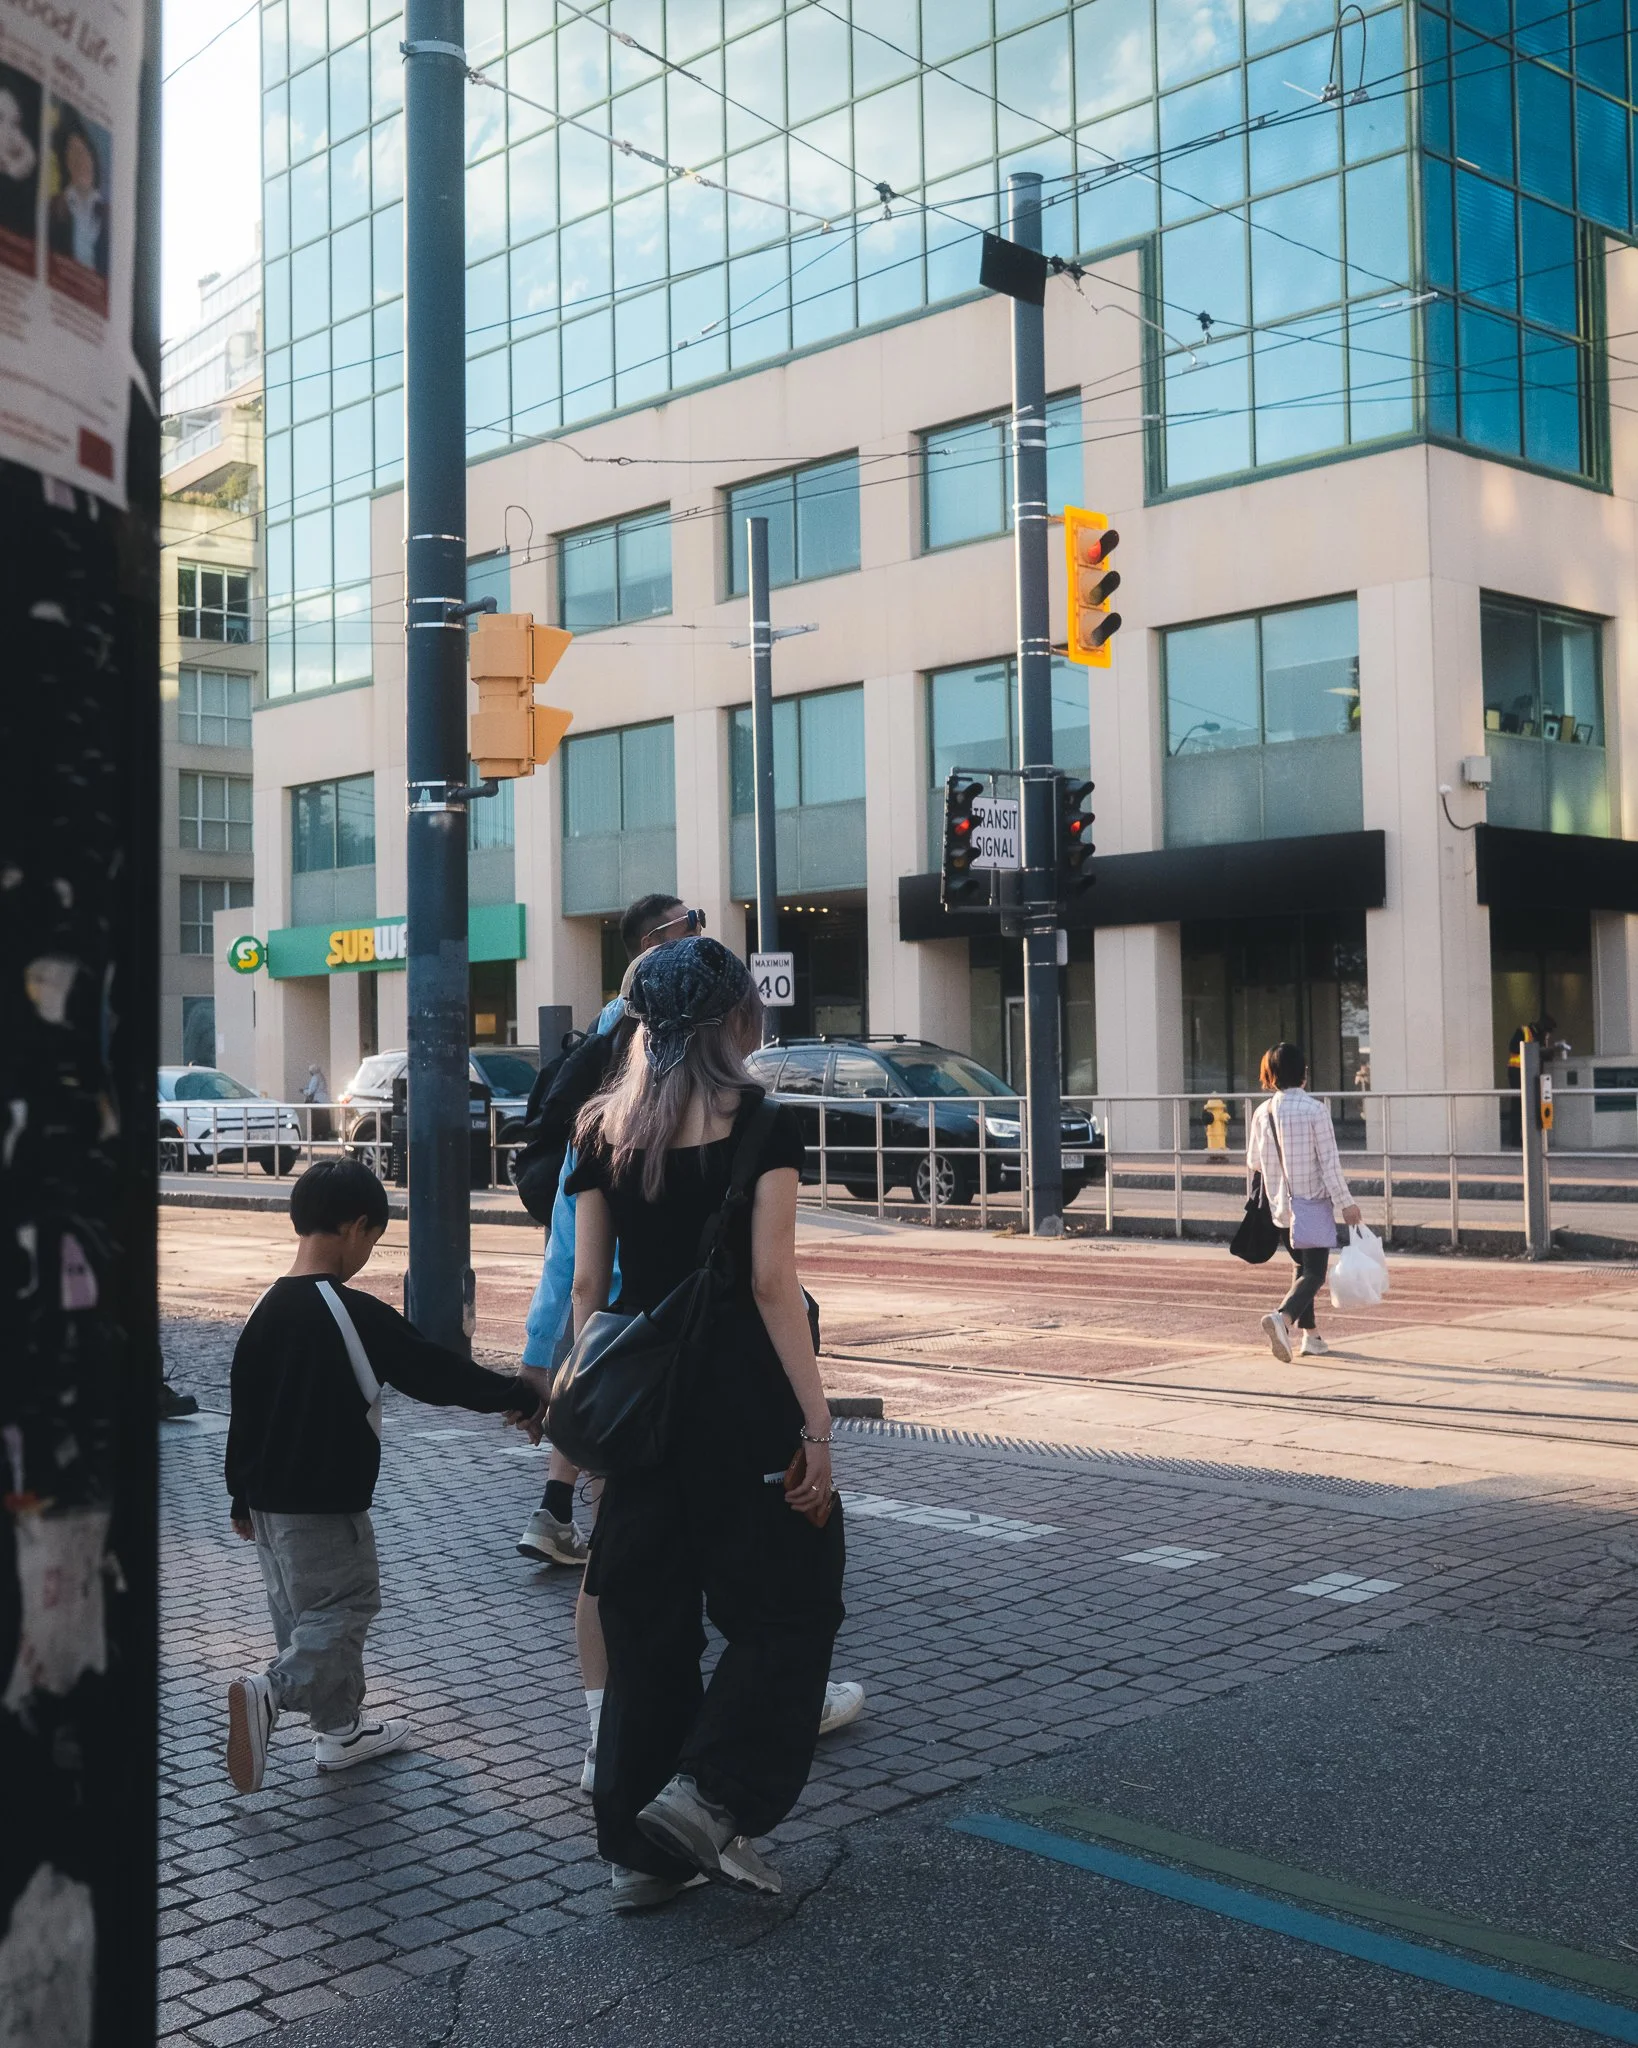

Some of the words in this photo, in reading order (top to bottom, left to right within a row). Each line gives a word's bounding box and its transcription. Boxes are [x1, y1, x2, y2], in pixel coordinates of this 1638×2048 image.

[973, 807, 1018, 830] TRANSIT
[975, 836, 1015, 858] SIGNAL
[325, 923, 407, 967] SUBW
[755, 959, 790, 968] MAXIMUM
[758, 975, 791, 999] 40
